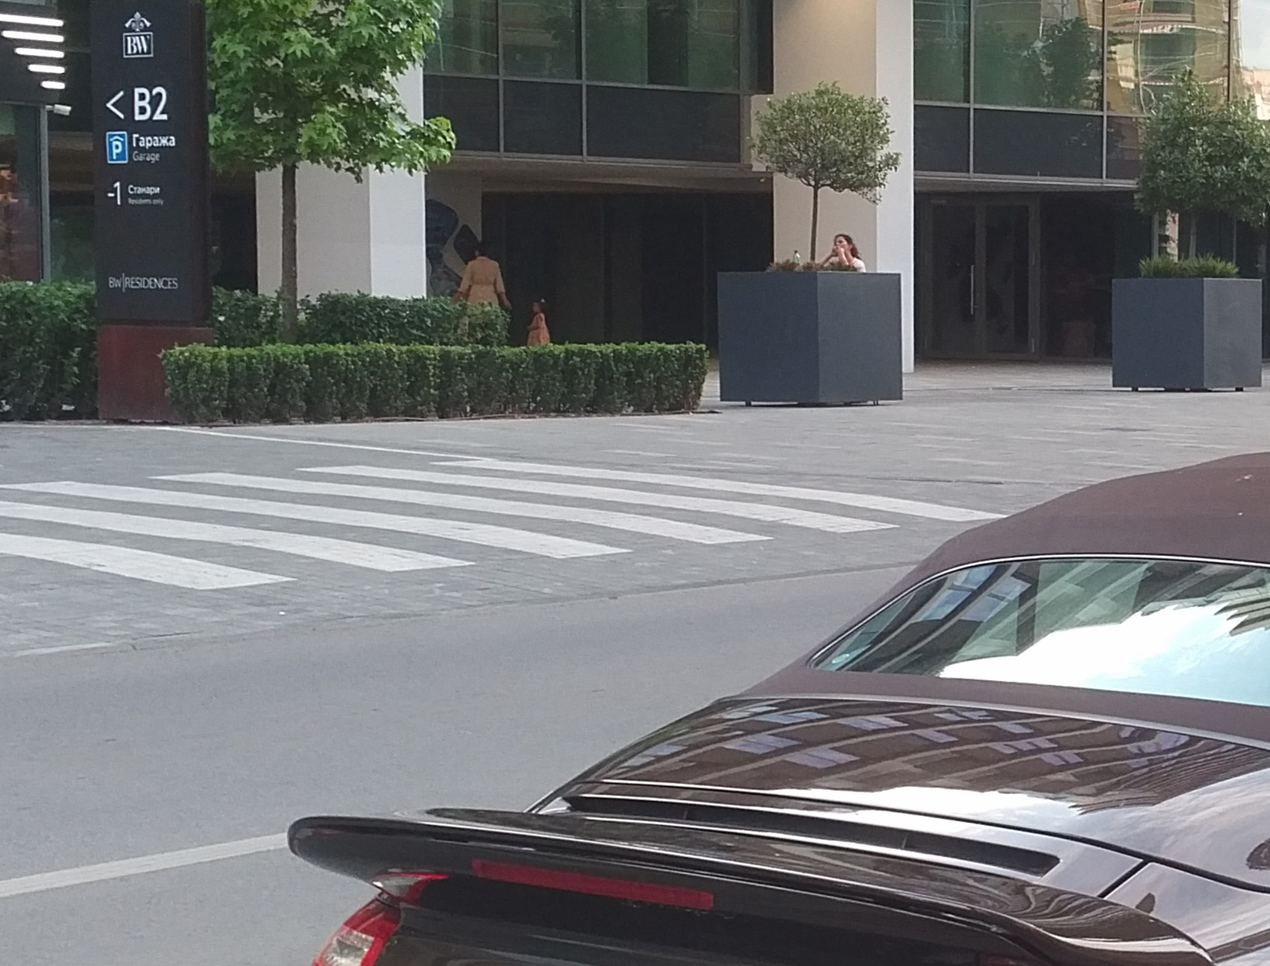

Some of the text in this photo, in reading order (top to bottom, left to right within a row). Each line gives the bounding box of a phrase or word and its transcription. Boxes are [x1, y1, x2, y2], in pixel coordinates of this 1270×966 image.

[126, 35, 151, 55] BW
[133, 86, 168, 122] B2
[132, 133, 176, 149] Гаража
[112, 140, 124, 161] P
[132, 150, 160, 163] Garage
[128, 185, 161, 196] Станари
